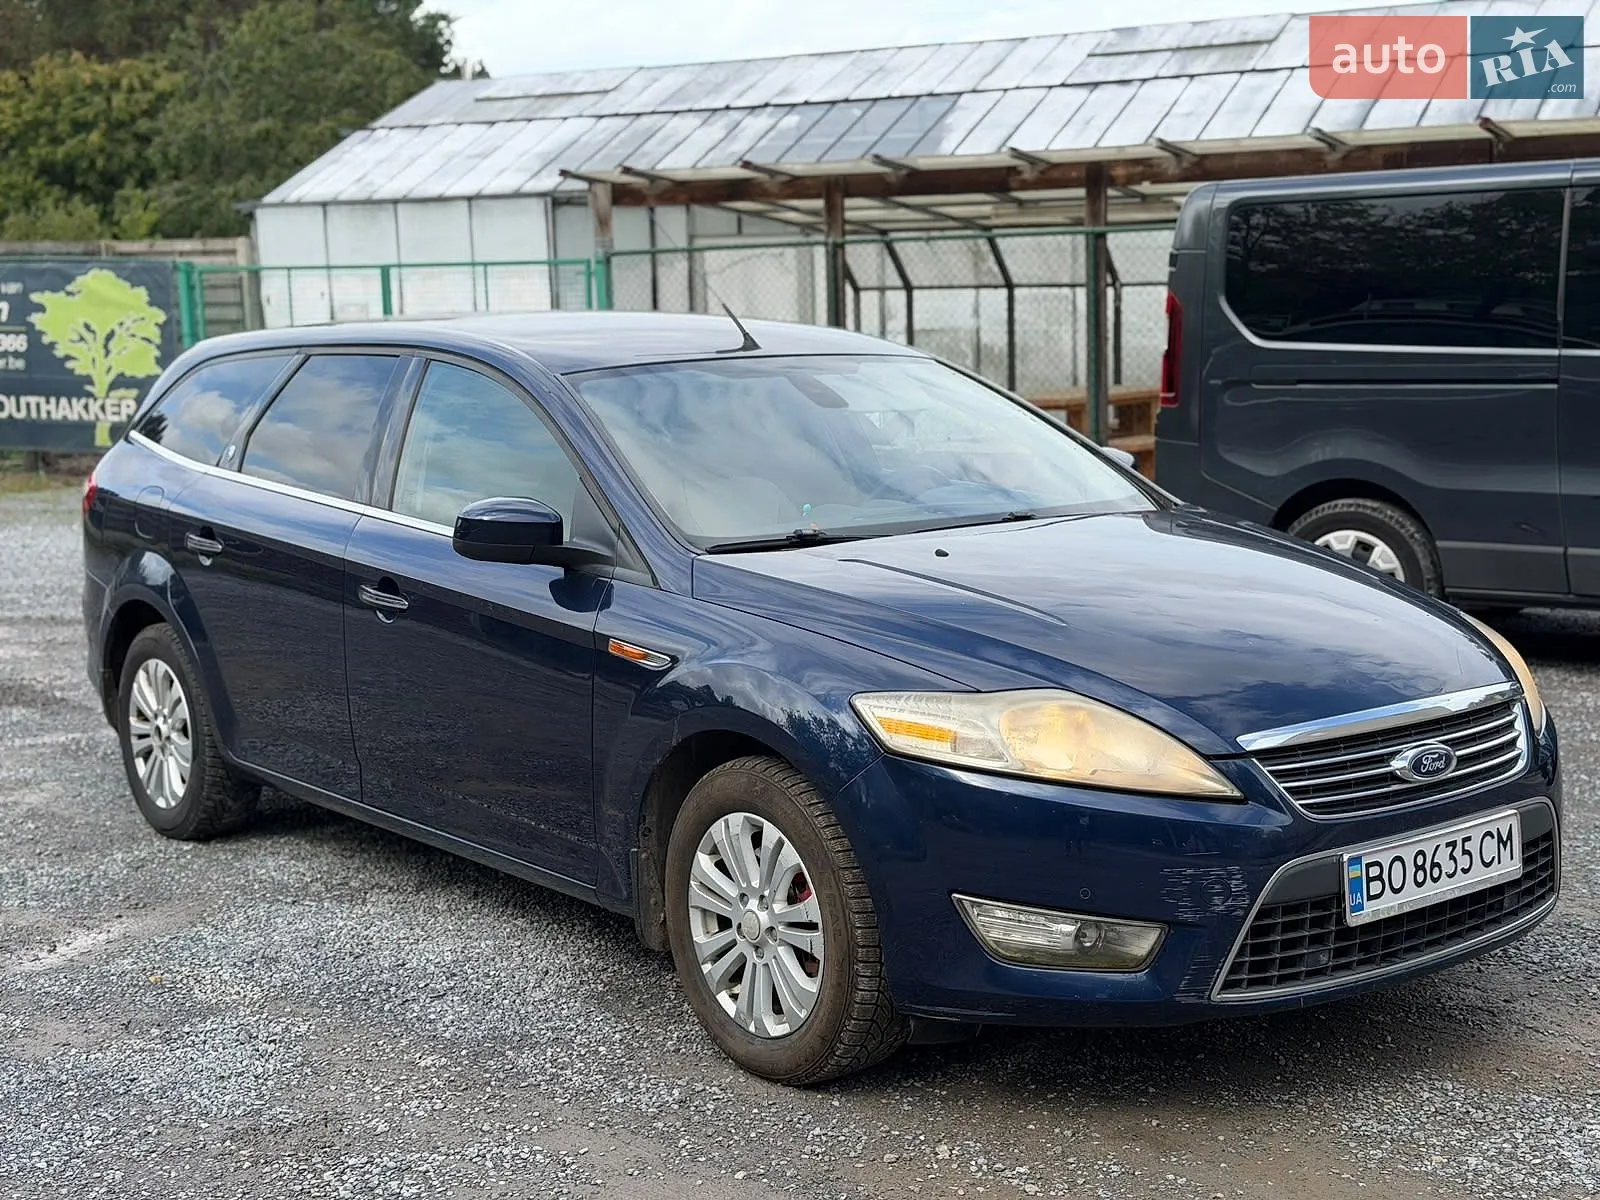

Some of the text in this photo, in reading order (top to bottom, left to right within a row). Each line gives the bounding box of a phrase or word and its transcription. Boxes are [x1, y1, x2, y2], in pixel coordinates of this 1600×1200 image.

[1420, 753, 1446, 773] Ford
[1365, 823, 1515, 902] BO 8635 CM
[1349, 892, 1363, 906] UA
